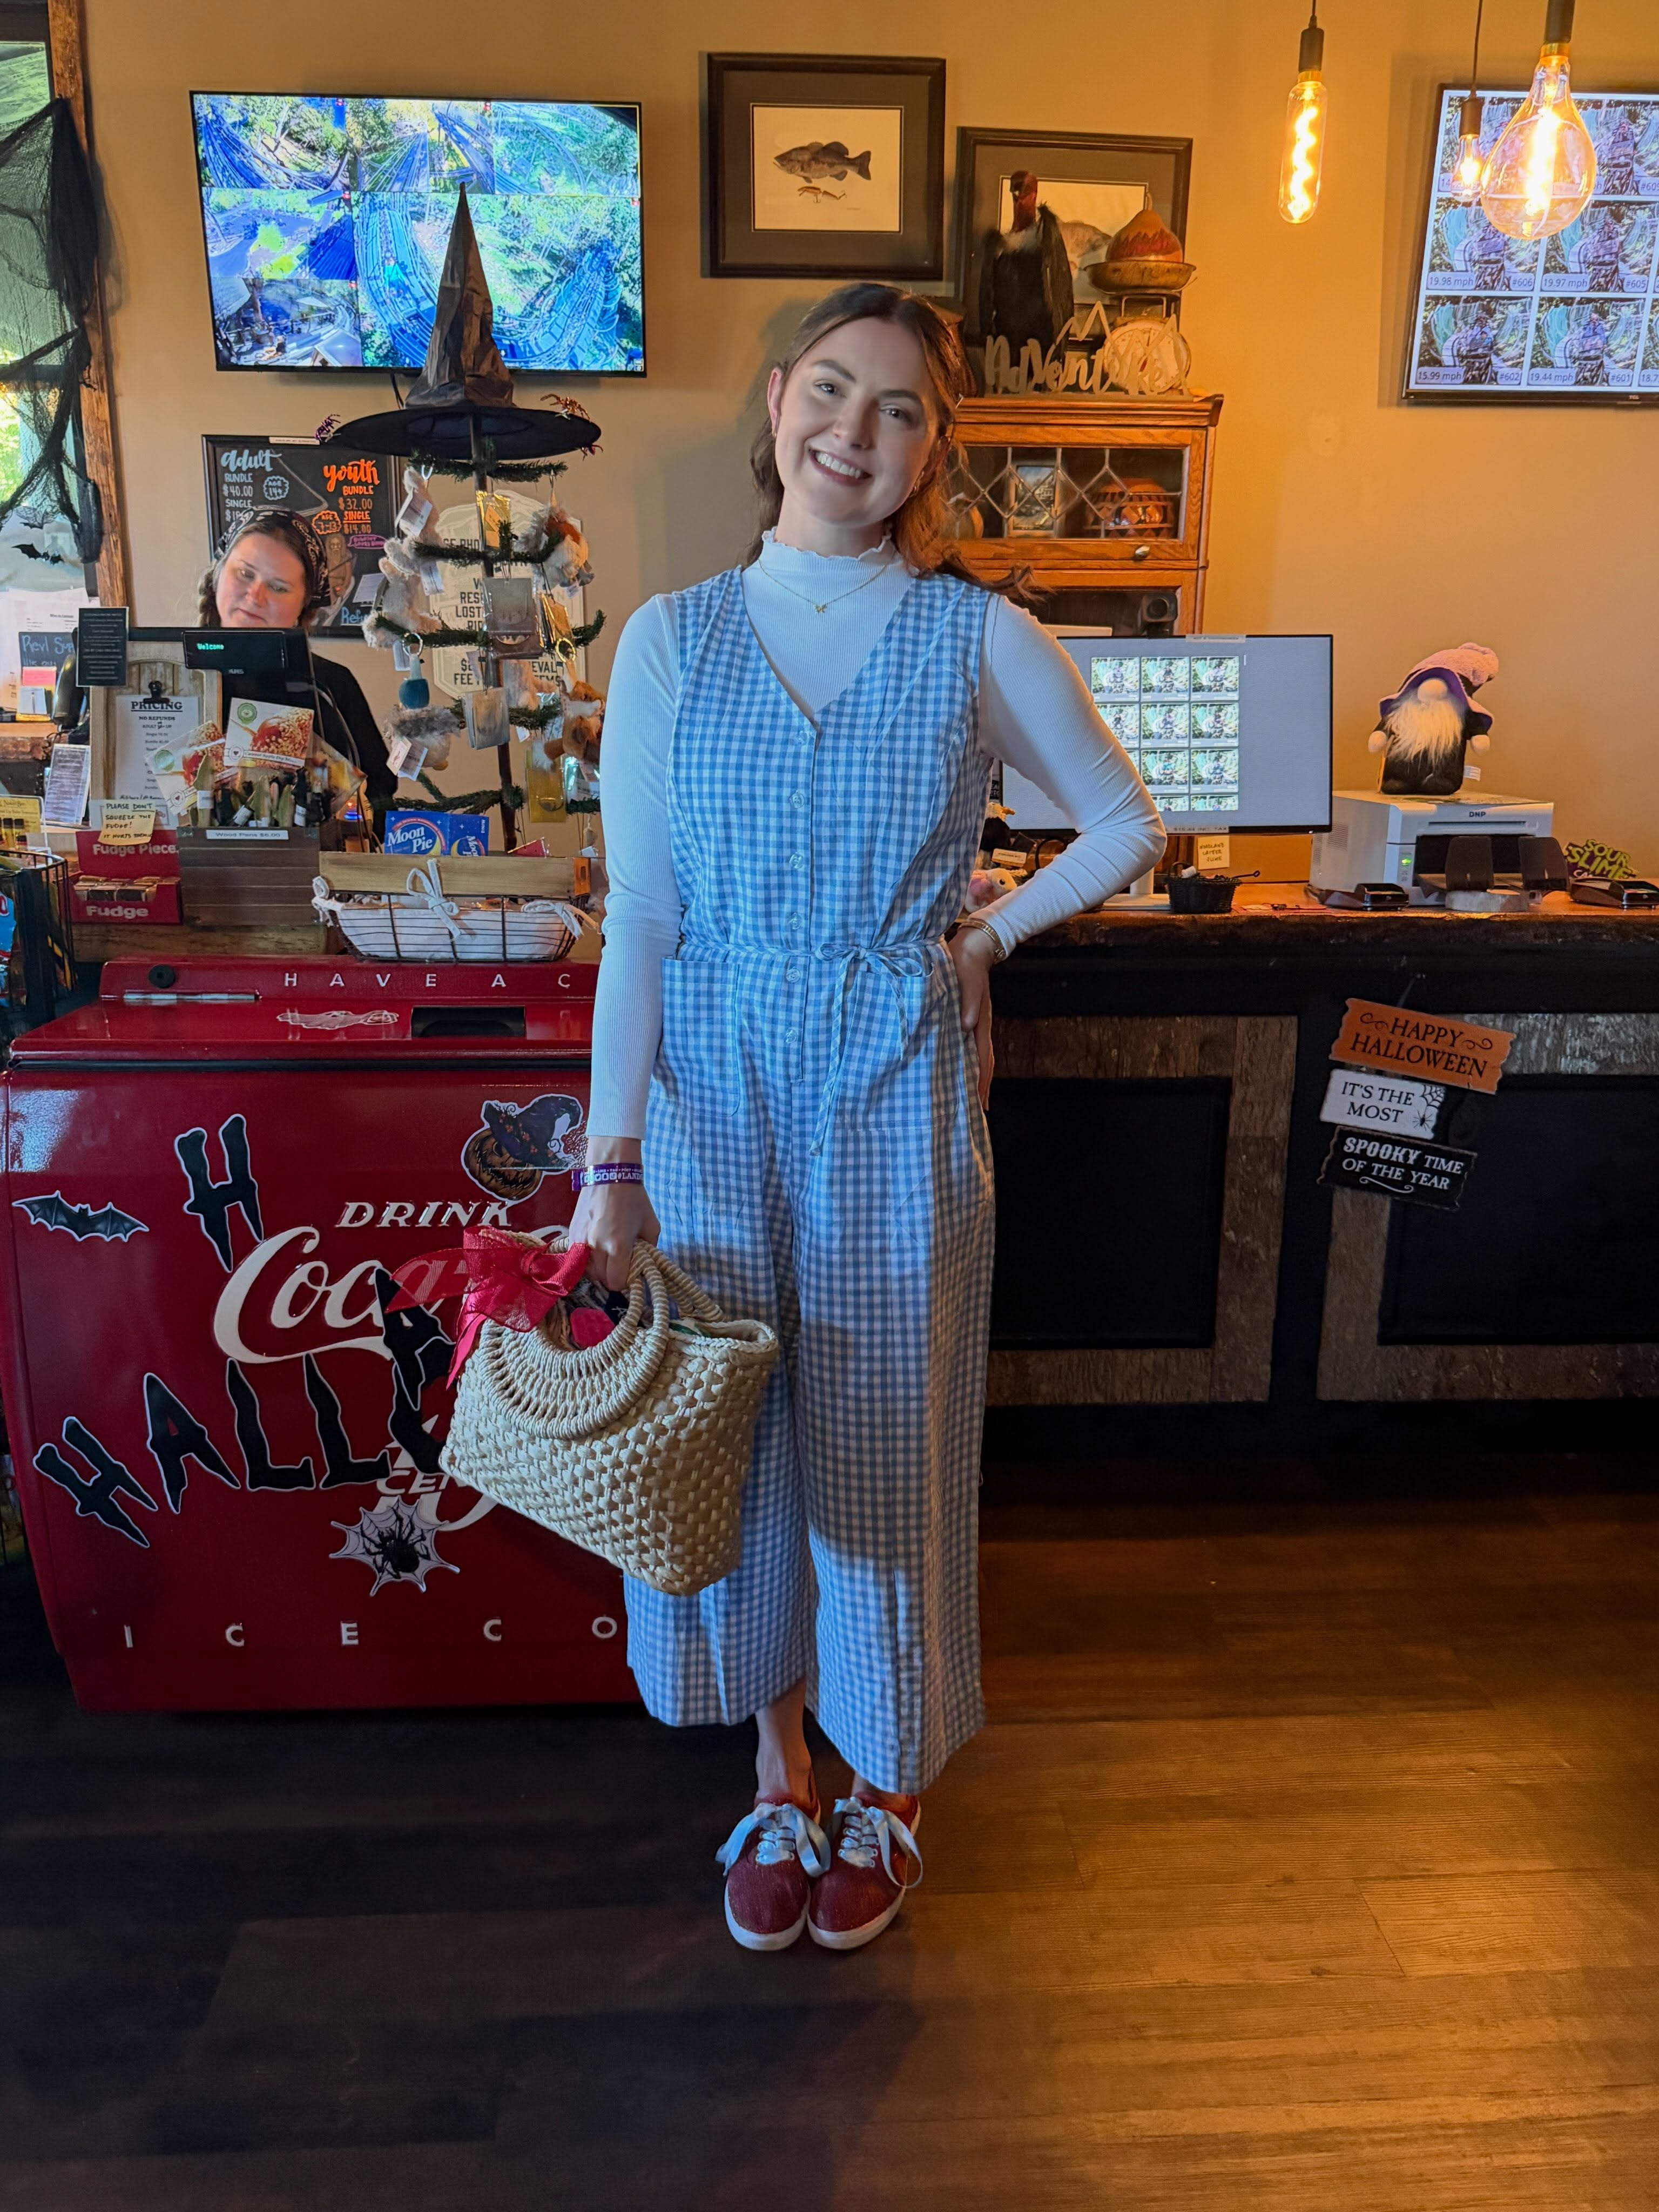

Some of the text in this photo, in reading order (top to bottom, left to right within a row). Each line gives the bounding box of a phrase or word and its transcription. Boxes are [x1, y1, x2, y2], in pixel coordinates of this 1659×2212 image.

[1429, 277, 1474, 287] 19.98 mph
[1512, 278, 1533, 287] #606
[1543, 278, 1588, 289] 19.97 mph
[1626, 279, 1646, 289] #605
[1418, 371, 1462, 382] 15.99 mph
[1499, 372, 1520, 381] #602
[1529, 372, 1574, 383] 19.44 mph
[1609, 374, 1630, 383] #601
[1642, 374, 1659, 382] 18.7
[225, 473, 253, 483] BUNDLE
[323, 458, 380, 493] youth
[222, 484, 253, 497] $40.00
[268, 487, 282, 496] 14+
[342, 485, 374, 496] BUNDLE
[225, 498, 253, 508] SINGLE
[338, 497, 373, 510] $32.00
[343, 511, 371, 521] SINGLE
[343, 524, 372, 535] $14.00
[131, 702, 183, 710] PRICING
[387, 826, 425, 847] Moon
[92, 843, 179, 857] Fudge Piece
[412, 836, 433, 853] Pie
[1584, 839, 1631, 868] SOUR
[1567, 846, 1633, 880] SLIME
[86, 905, 149, 919] Fudge
[1390, 1017, 1465, 1048] HAPPY
[1350, 1033, 1488, 1079] HALLOWEEN
[1341, 1081, 1415, 1106] IT'S THE
[1346, 1102, 1404, 1123] MOST
[1343, 1137, 1465, 1175] SPOOKY TIME
[1342, 1158, 1451, 1190] OF THE YEAR
[334, 1200, 512, 1228] DRINK
